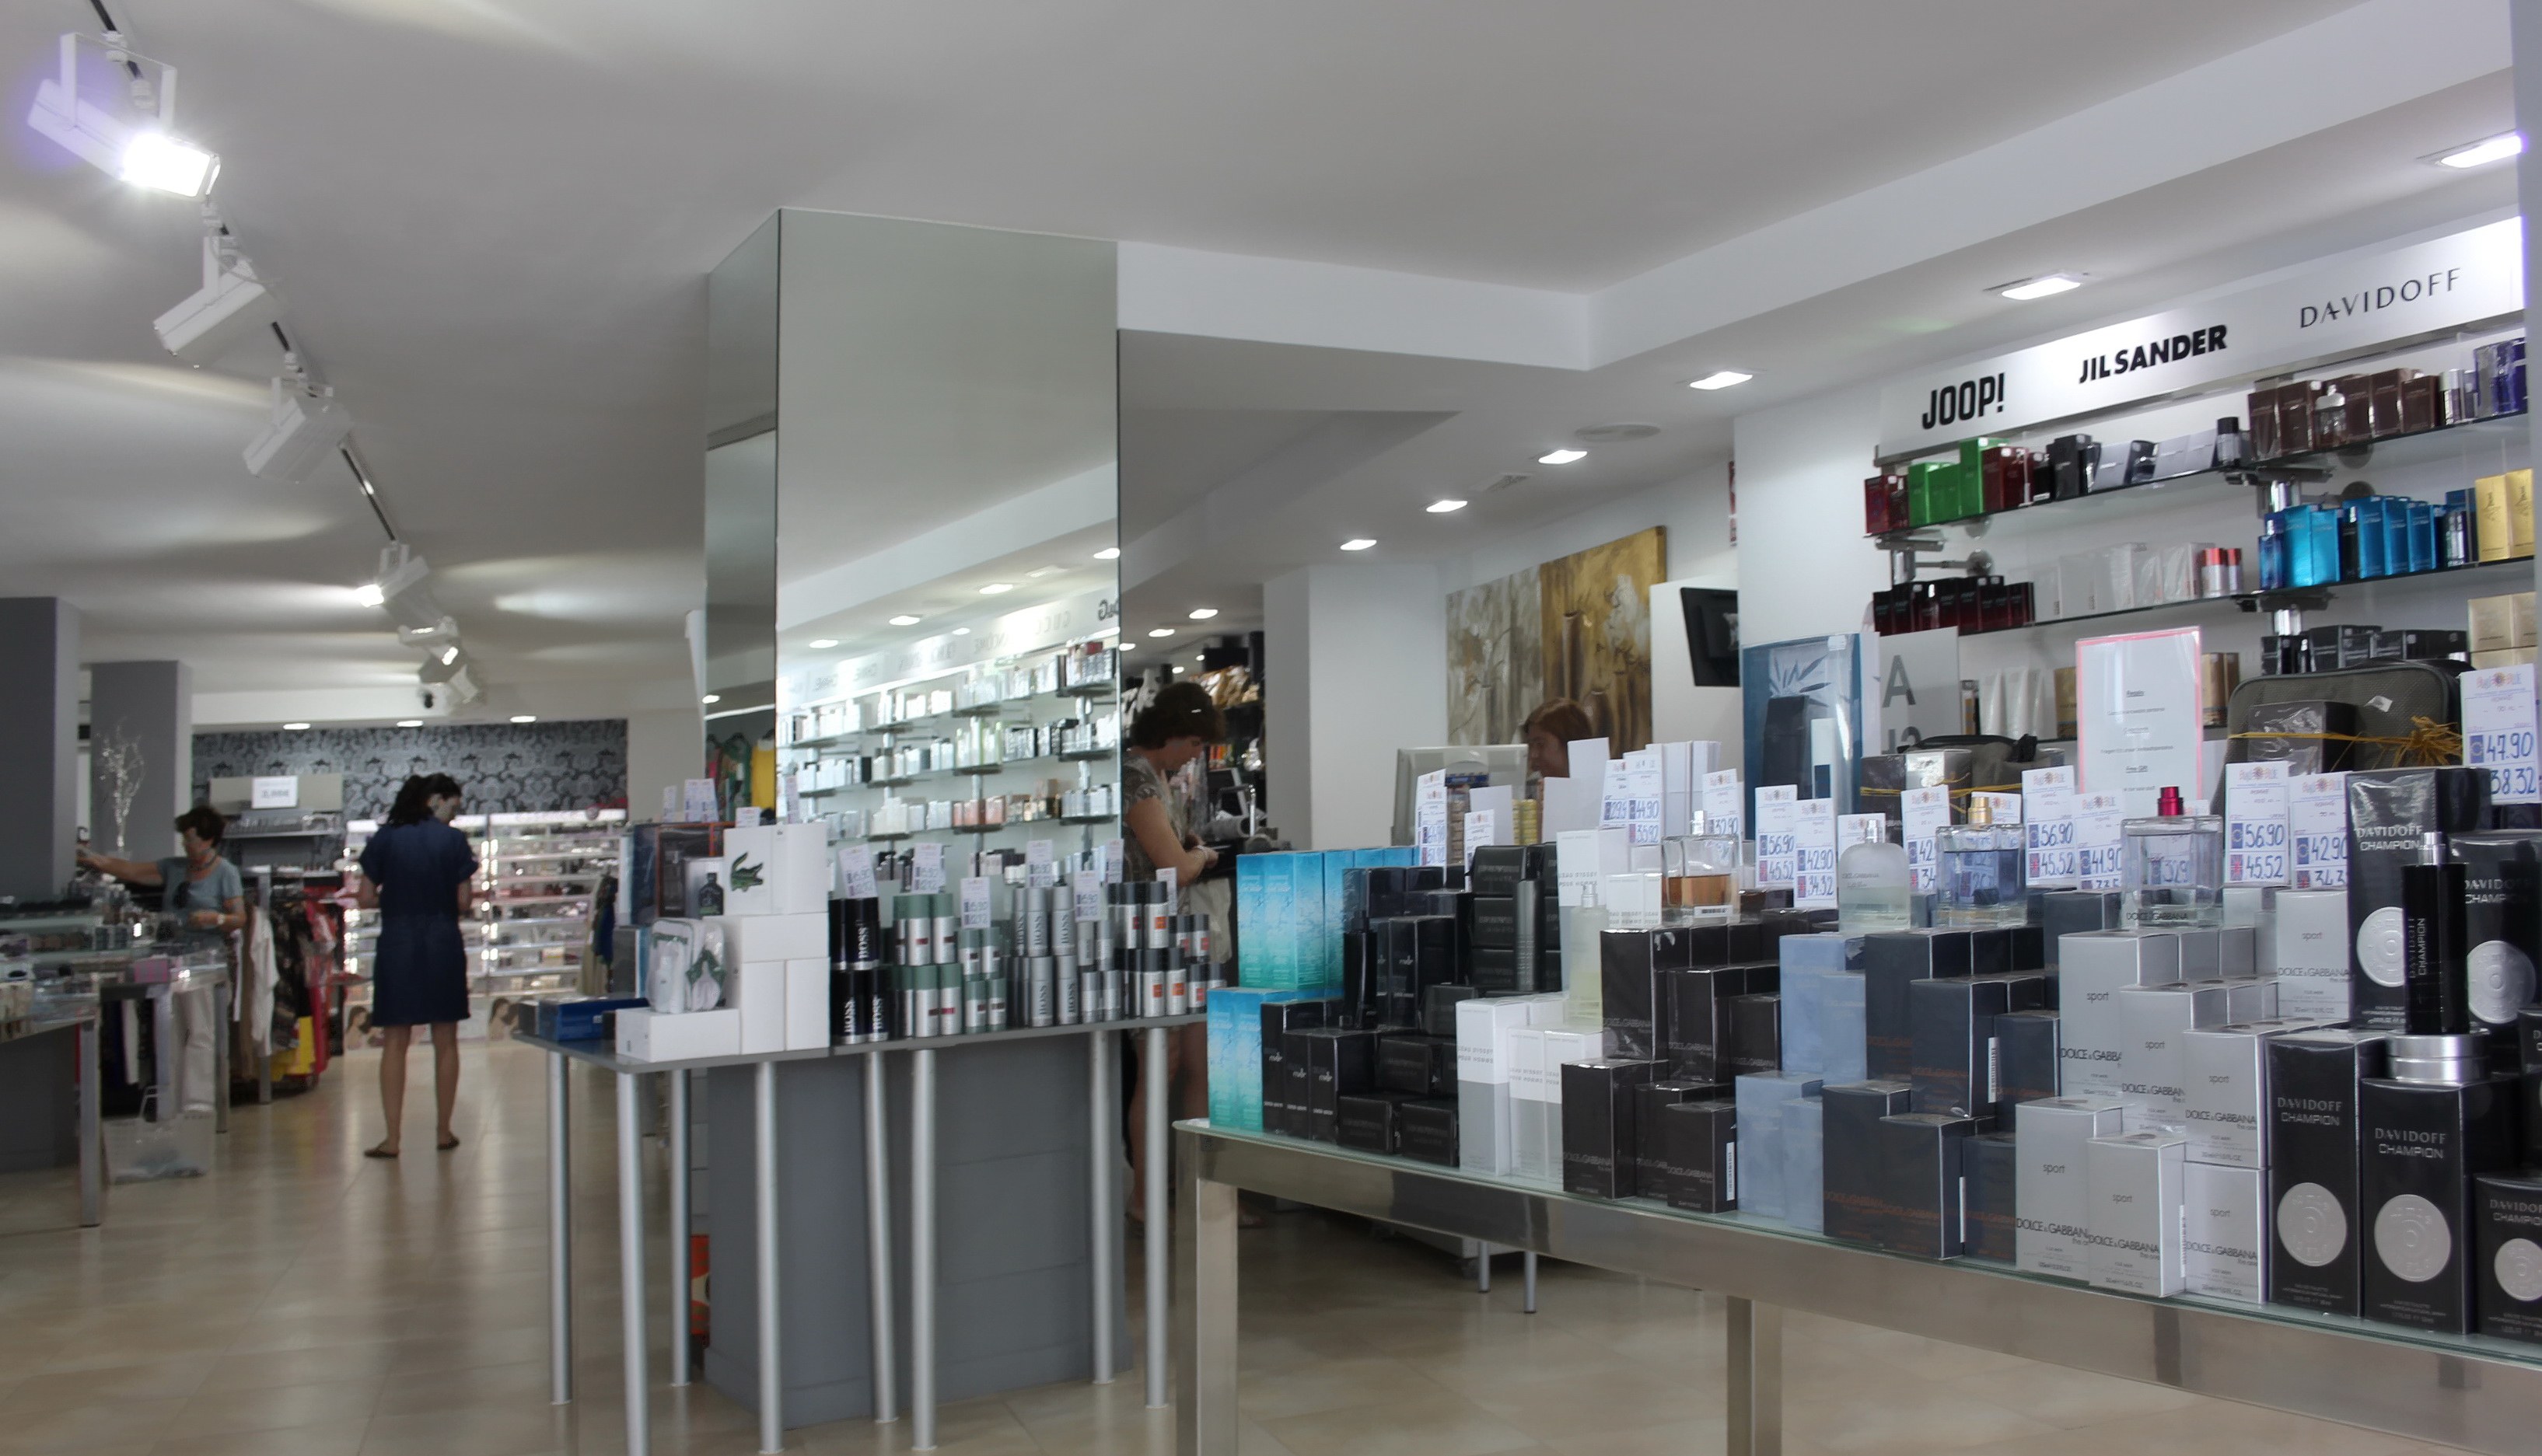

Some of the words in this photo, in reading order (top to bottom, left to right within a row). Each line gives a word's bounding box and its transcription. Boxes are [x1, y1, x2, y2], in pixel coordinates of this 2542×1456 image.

[2300, 267, 2461, 328] DAVIDOFF
[2079, 356, 2110, 384] JIL
[2114, 324, 2227, 376] SANDER
[1921, 372, 2005, 430] JOOP!
[2487, 731, 2533, 762] 47.90
[2355, 825, 2424, 838] DAVIDOFF
[2360, 840, 2420, 852] CHAMPION
[2246, 855, 2284, 880] 45.52
[2418, 918, 2426, 976] CHAMPION
[2086, 992, 2109, 1004] sport
[2145, 1041, 2165, 1051] sport
[2122, 1083, 2185, 1095] DOLCE&GABBAN
[2278, 1097, 2342, 1112] DAVIDOFF
[2281, 1112, 2340, 1126] CHAMPION
[2375, 1128, 2446, 1144] DAVIDOFF
[2379, 1144, 2443, 1159] CHAMPION
[2043, 1164, 2065, 1175] sport
[2113, 1194, 2133, 1204] sport
[2490, 1199, 2542, 1214] DAVIDO
[2016, 1218, 2089, 1238] DOLCE&GABBAN
